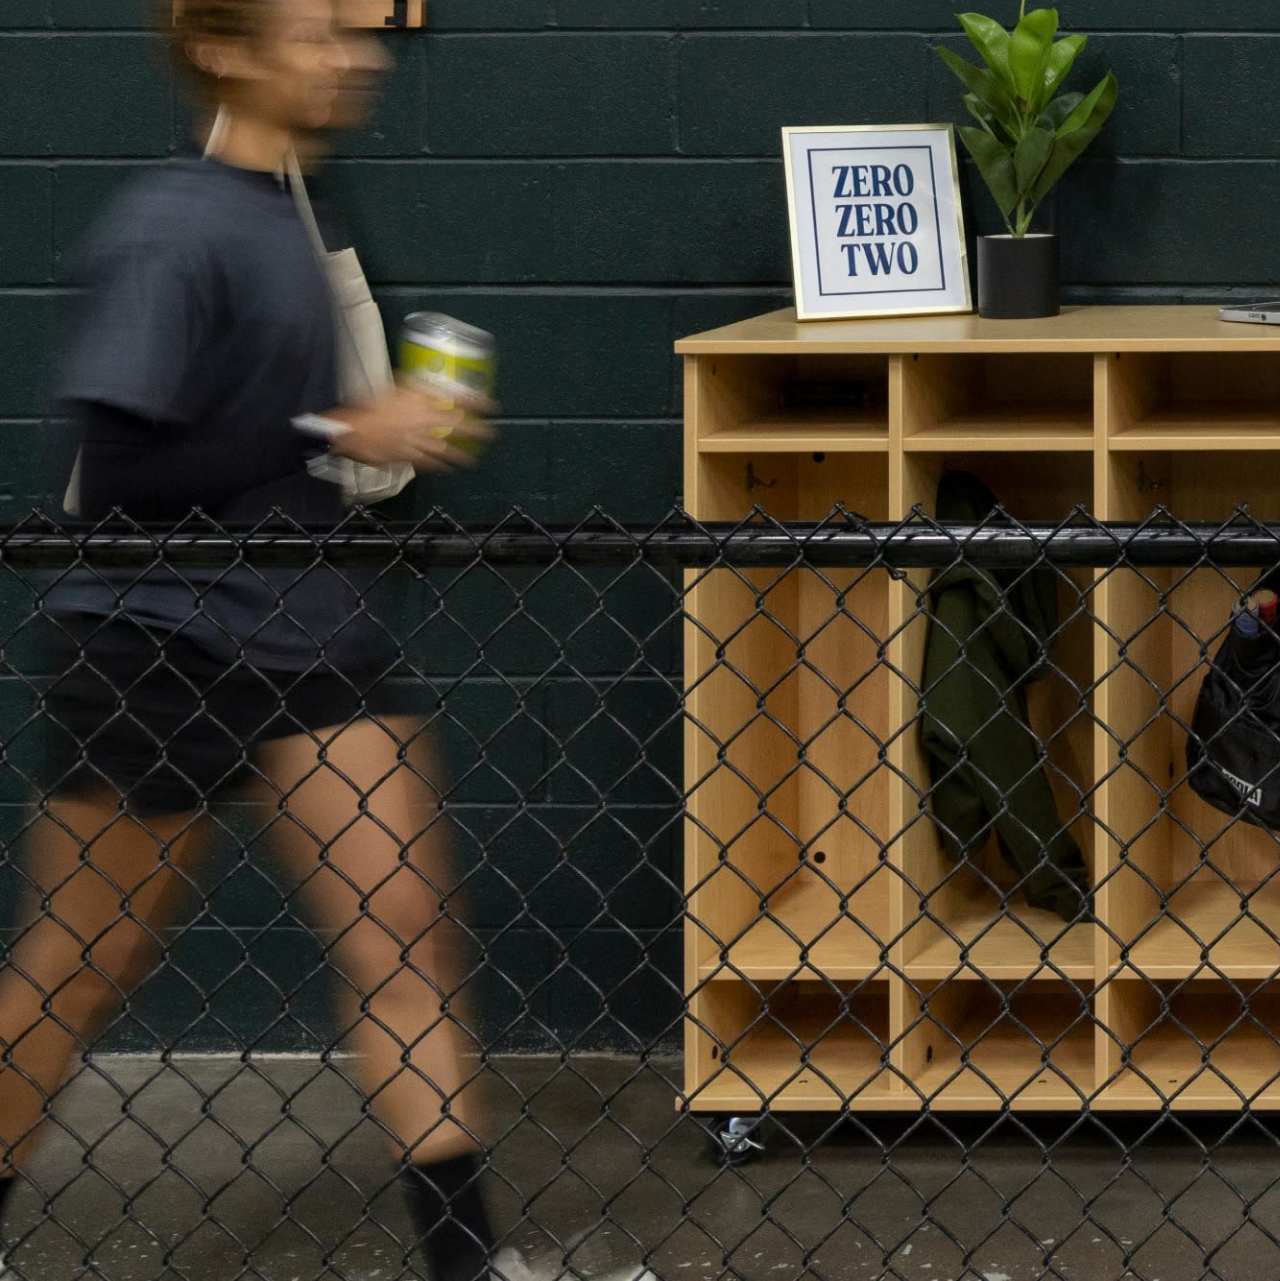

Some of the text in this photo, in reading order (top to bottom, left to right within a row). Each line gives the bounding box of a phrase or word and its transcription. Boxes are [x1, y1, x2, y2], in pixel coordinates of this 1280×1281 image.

[831, 163, 914, 198] ZERO
[835, 202, 918, 237] ZERO
[840, 241, 918, 277] TWO
